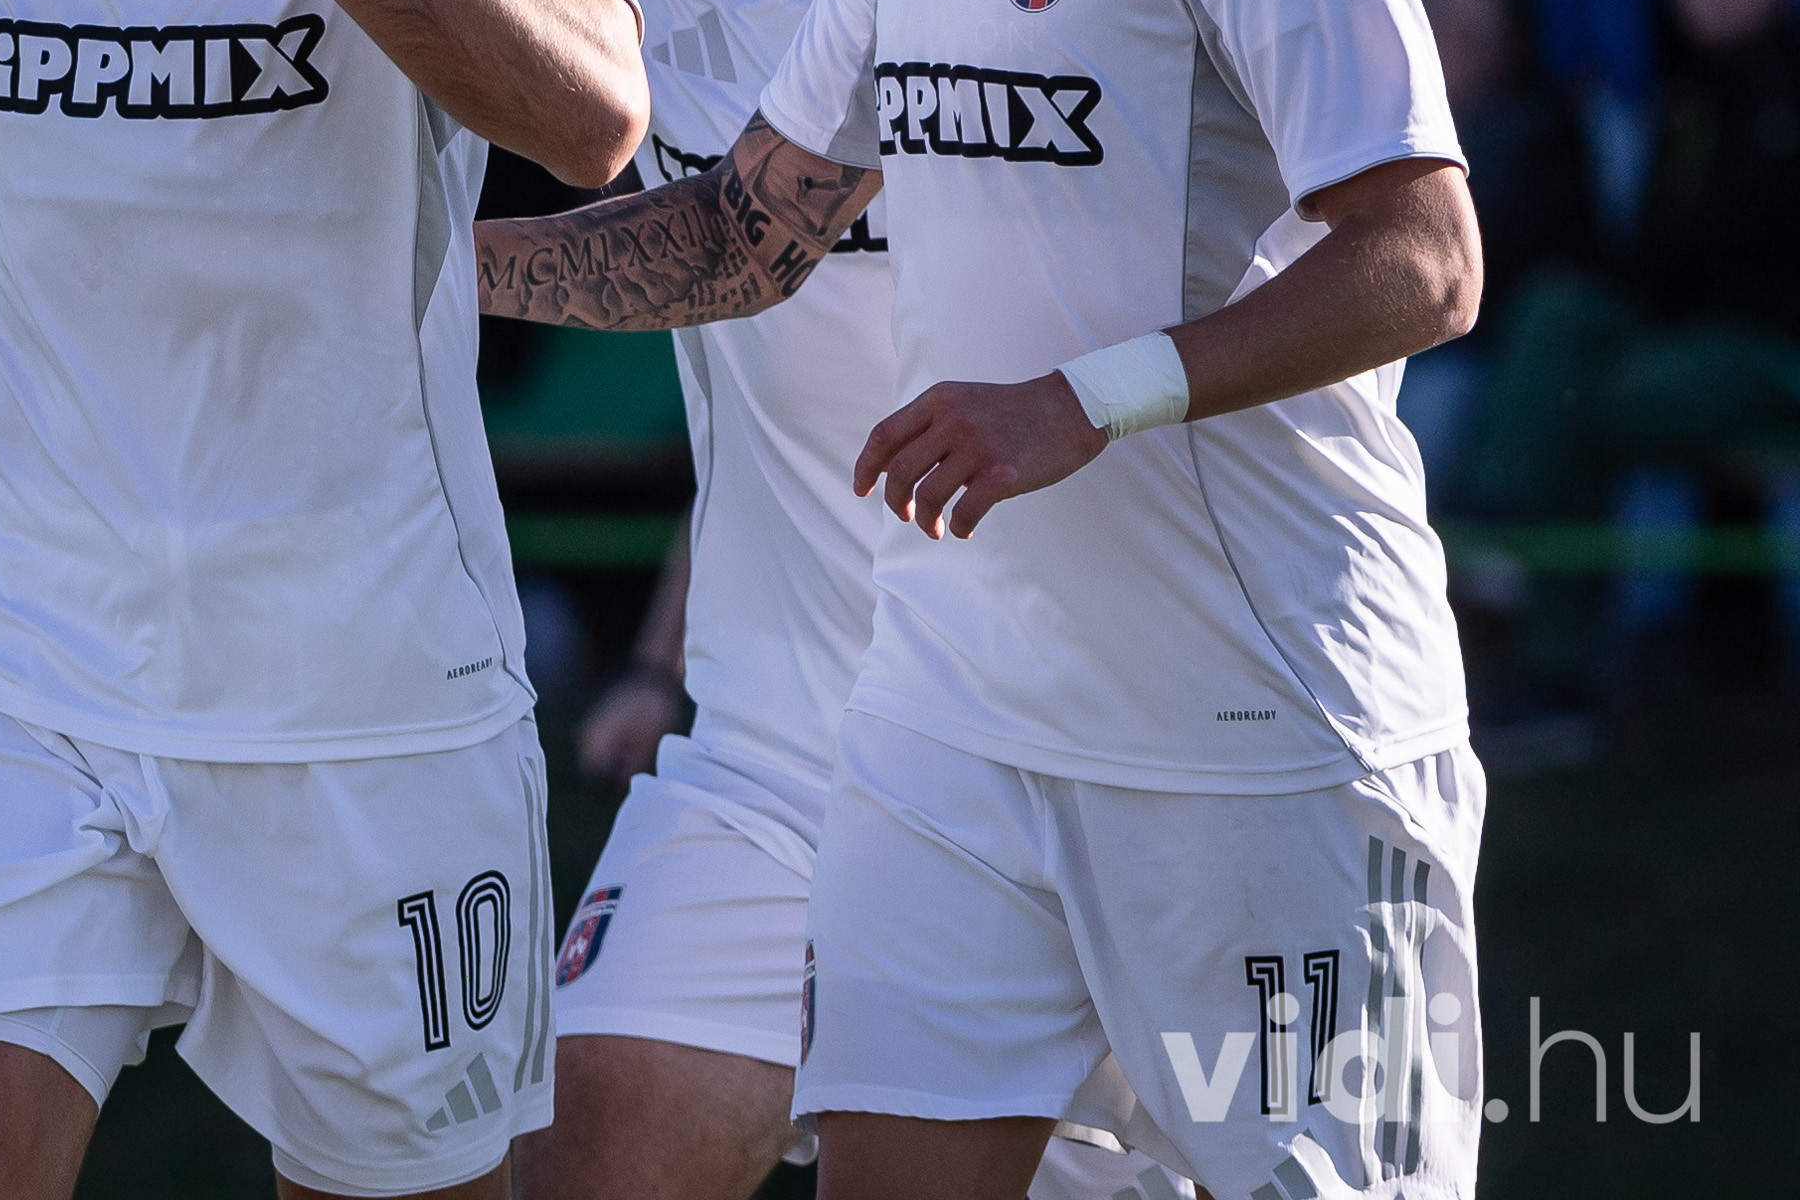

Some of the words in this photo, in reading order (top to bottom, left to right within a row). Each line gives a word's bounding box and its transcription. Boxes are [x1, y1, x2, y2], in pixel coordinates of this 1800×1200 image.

[875, 62, 1104, 166] PPMIX
[723, 170, 773, 248] BIG
[446, 657, 493, 680] AEROREADY
[1216, 709, 1277, 721] AEROREADY
[397, 869, 511, 1053] 10
[1244, 949, 1340, 1116] 11
